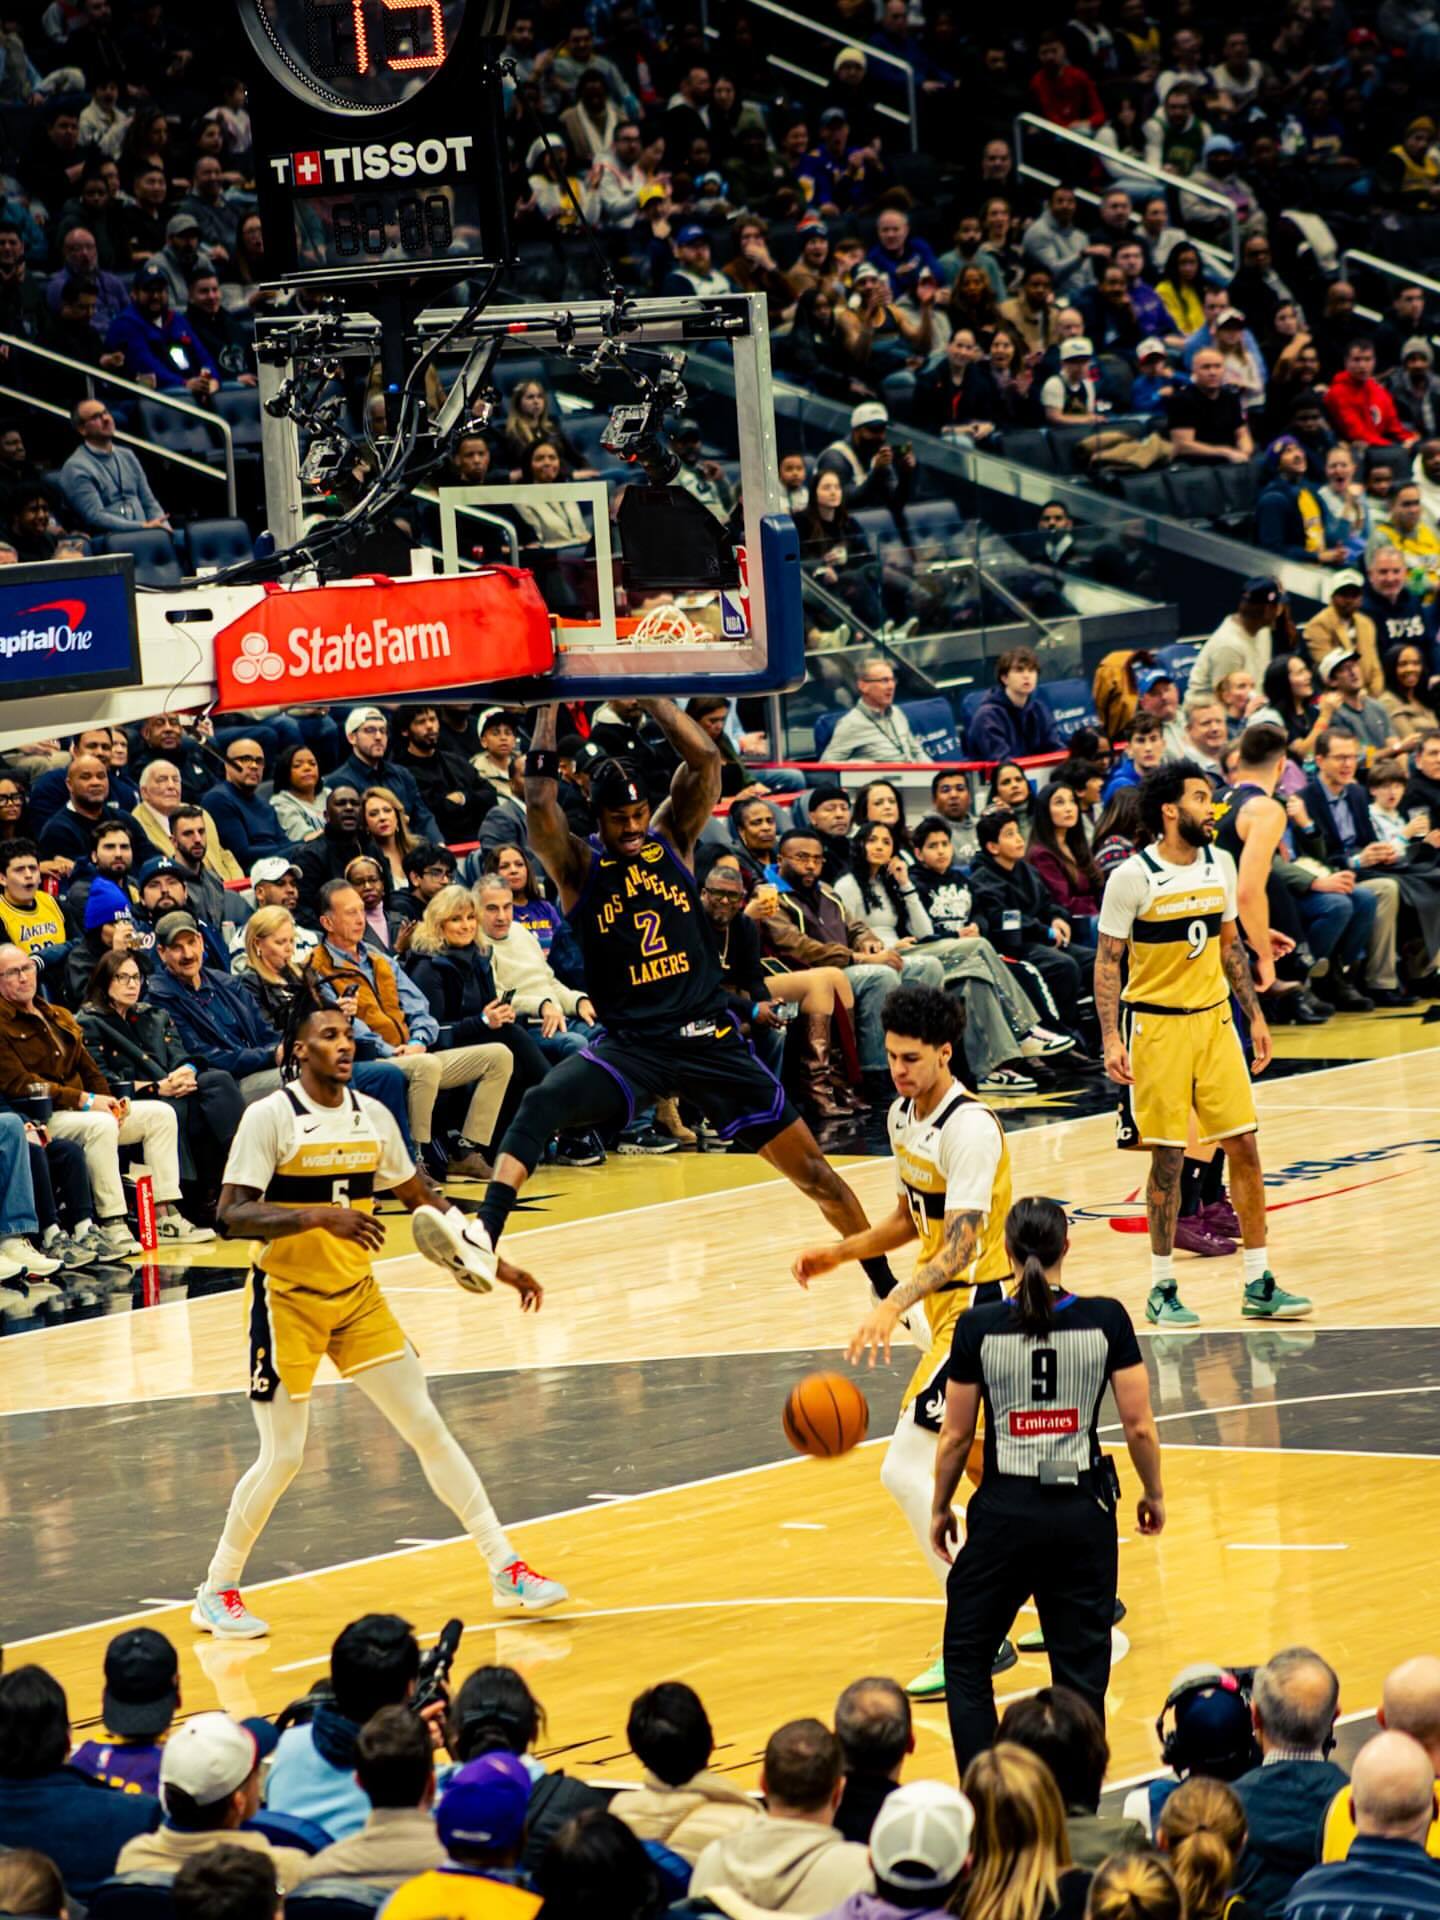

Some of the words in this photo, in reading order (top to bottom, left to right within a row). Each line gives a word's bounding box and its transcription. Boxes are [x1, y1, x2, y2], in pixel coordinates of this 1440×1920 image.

[324, 136, 473, 183] TISSOT
[597, 894, 624, 934] LOS
[624, 864, 690, 913] ANGELES
[634, 910, 668, 957] 2
[1187, 919, 1208, 960] 9
[629, 952, 690, 986] LAKERS
[332, 1179, 351, 1209] 5
[1032, 1349, 1057, 1401] 9
[1016, 1415, 1073, 1431] Emirates
